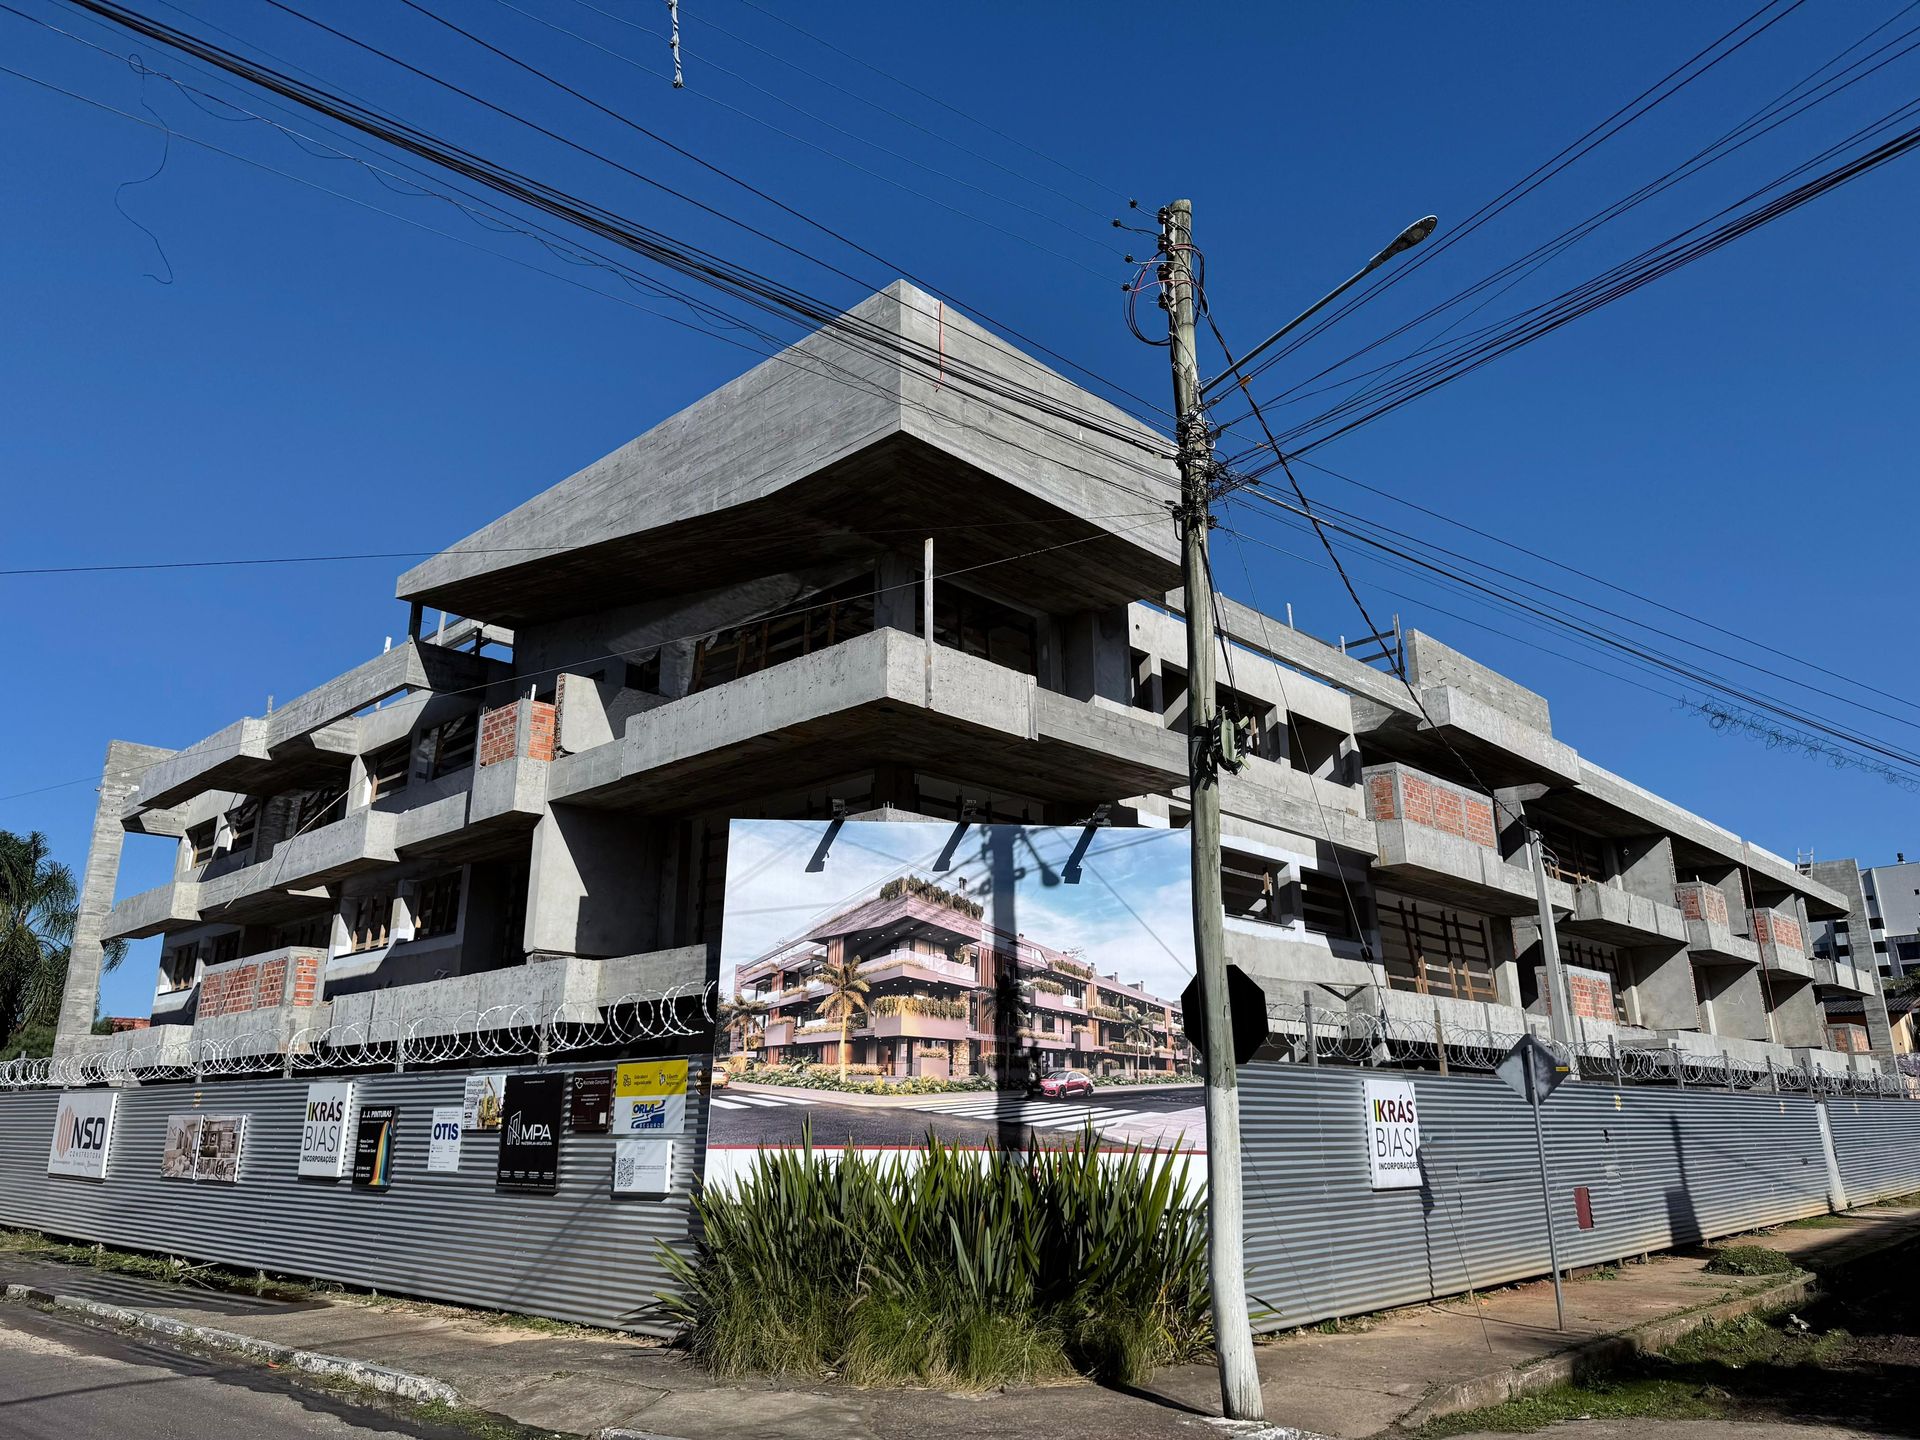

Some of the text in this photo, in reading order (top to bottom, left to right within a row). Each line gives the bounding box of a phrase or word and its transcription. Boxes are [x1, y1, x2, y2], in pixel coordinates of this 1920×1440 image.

[371, 1110, 392, 1118] PINTURAS
[632, 1103, 655, 1114] ORLA
[71, 1116, 106, 1150] NSO
[303, 1125, 341, 1152] BIASI
[433, 1123, 459, 1140] OTIS
[521, 1123, 552, 1141] MPA
[1376, 1127, 1418, 1158] BIASI
[302, 1154, 337, 1164] INCORPORAÇÕES
[1378, 1159, 1420, 1172] INCORPORAÇÕES
